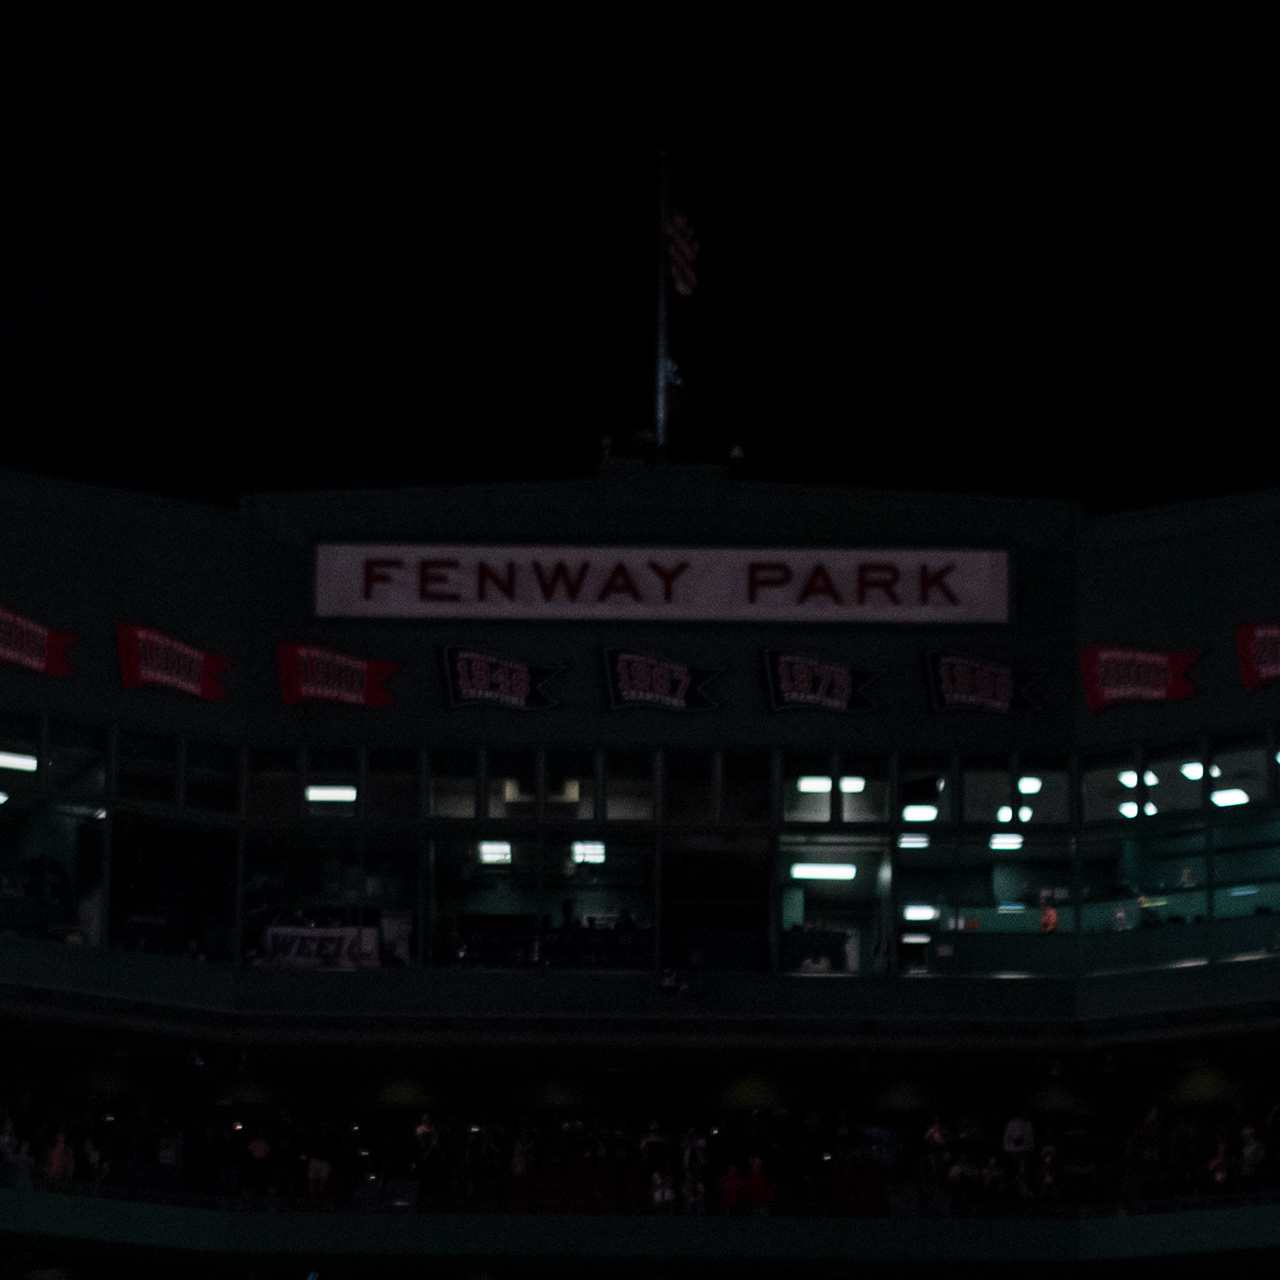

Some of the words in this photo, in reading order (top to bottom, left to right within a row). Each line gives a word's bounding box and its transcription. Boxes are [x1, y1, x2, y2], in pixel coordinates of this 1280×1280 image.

[363, 560, 689, 602] FENWAY
[748, 563, 960, 605] PARK
[617, 660, 690, 699] 1967
[778, 661, 851, 700] 1975
